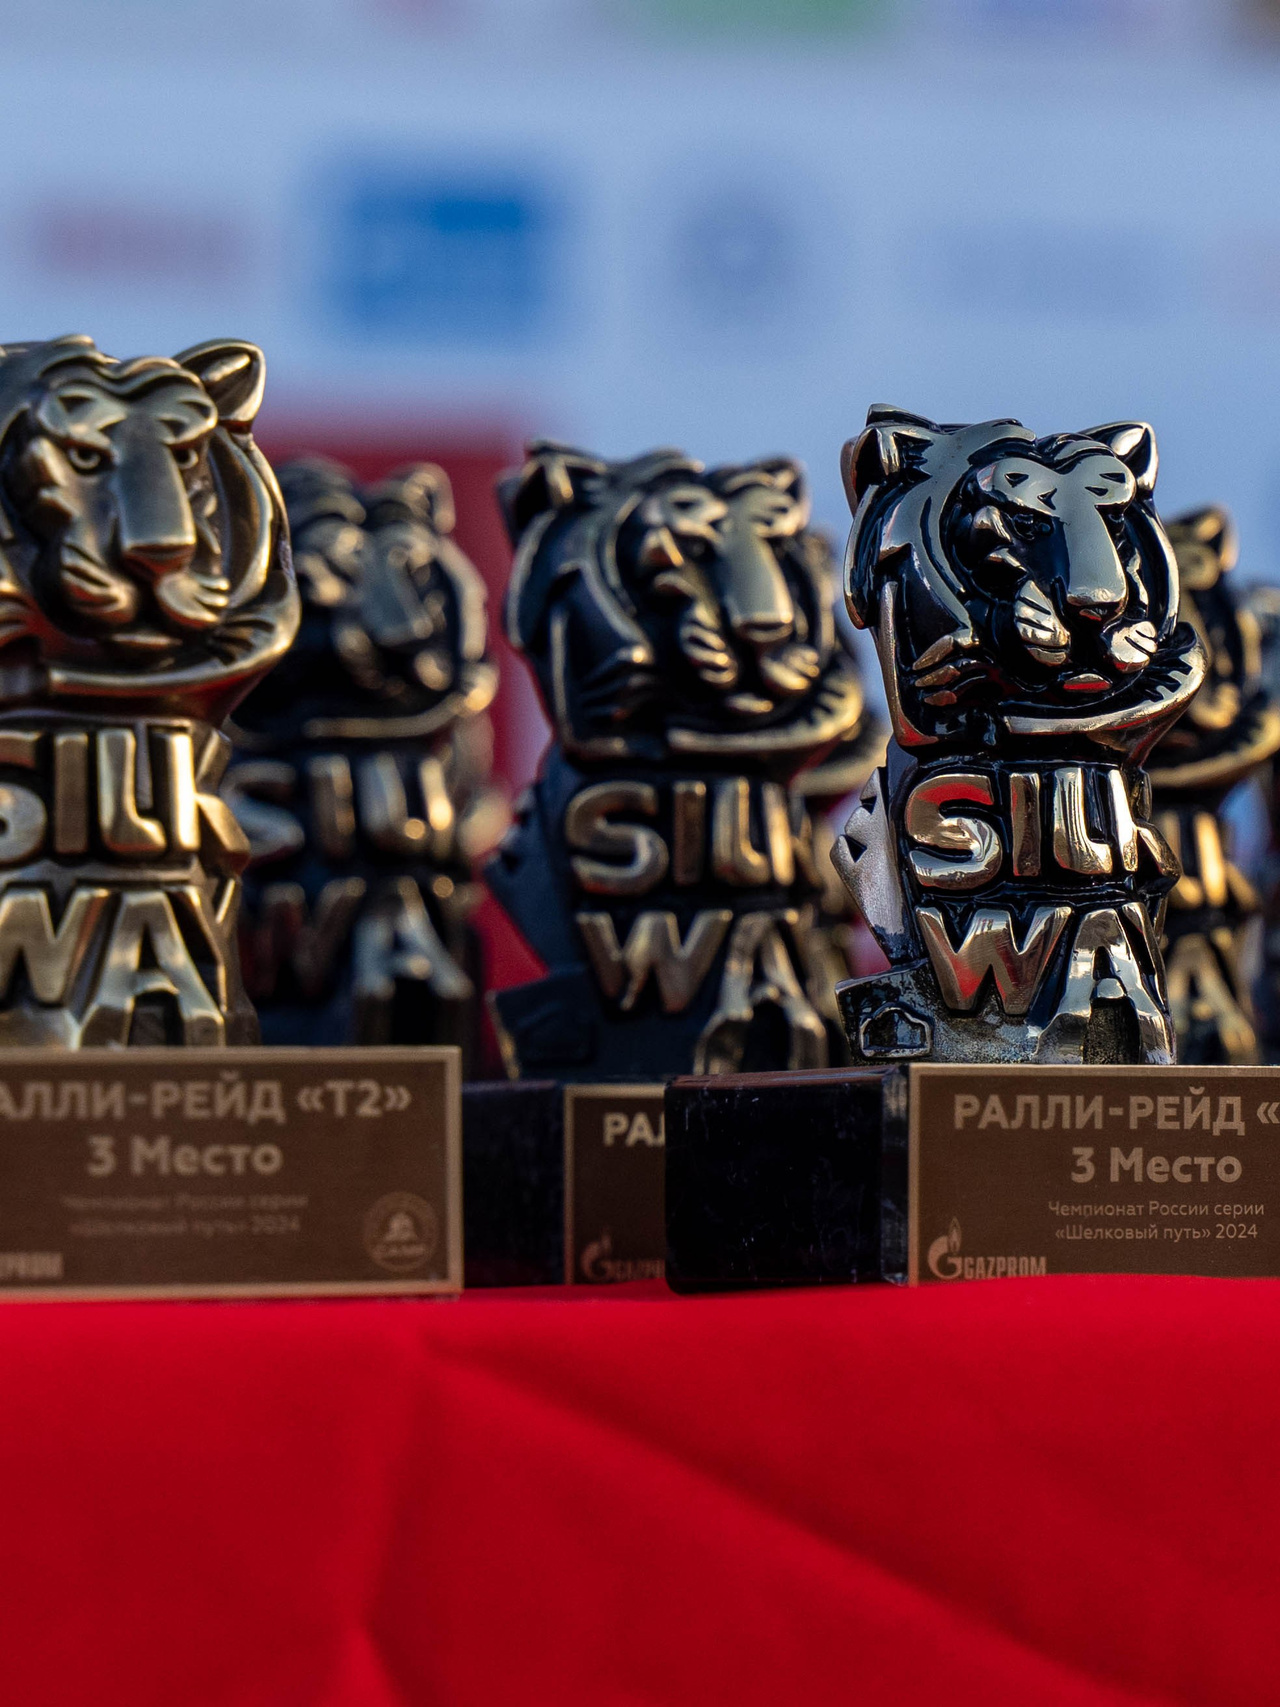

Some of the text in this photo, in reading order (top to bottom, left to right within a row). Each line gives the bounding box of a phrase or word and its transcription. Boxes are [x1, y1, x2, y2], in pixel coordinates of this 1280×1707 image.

[955, 1087, 1245, 1136] РАЛЛИ-РЕЙД
[88, 1136, 282, 1176] 3 Место
[1072, 1147, 1242, 1183] 3 Место
[1048, 1201, 1265, 1219] Чемпионат России серии
[1056, 1223, 1257, 1243] «Шелковый путь» 2024
[963, 1256, 1047, 1279] GAZPROM
